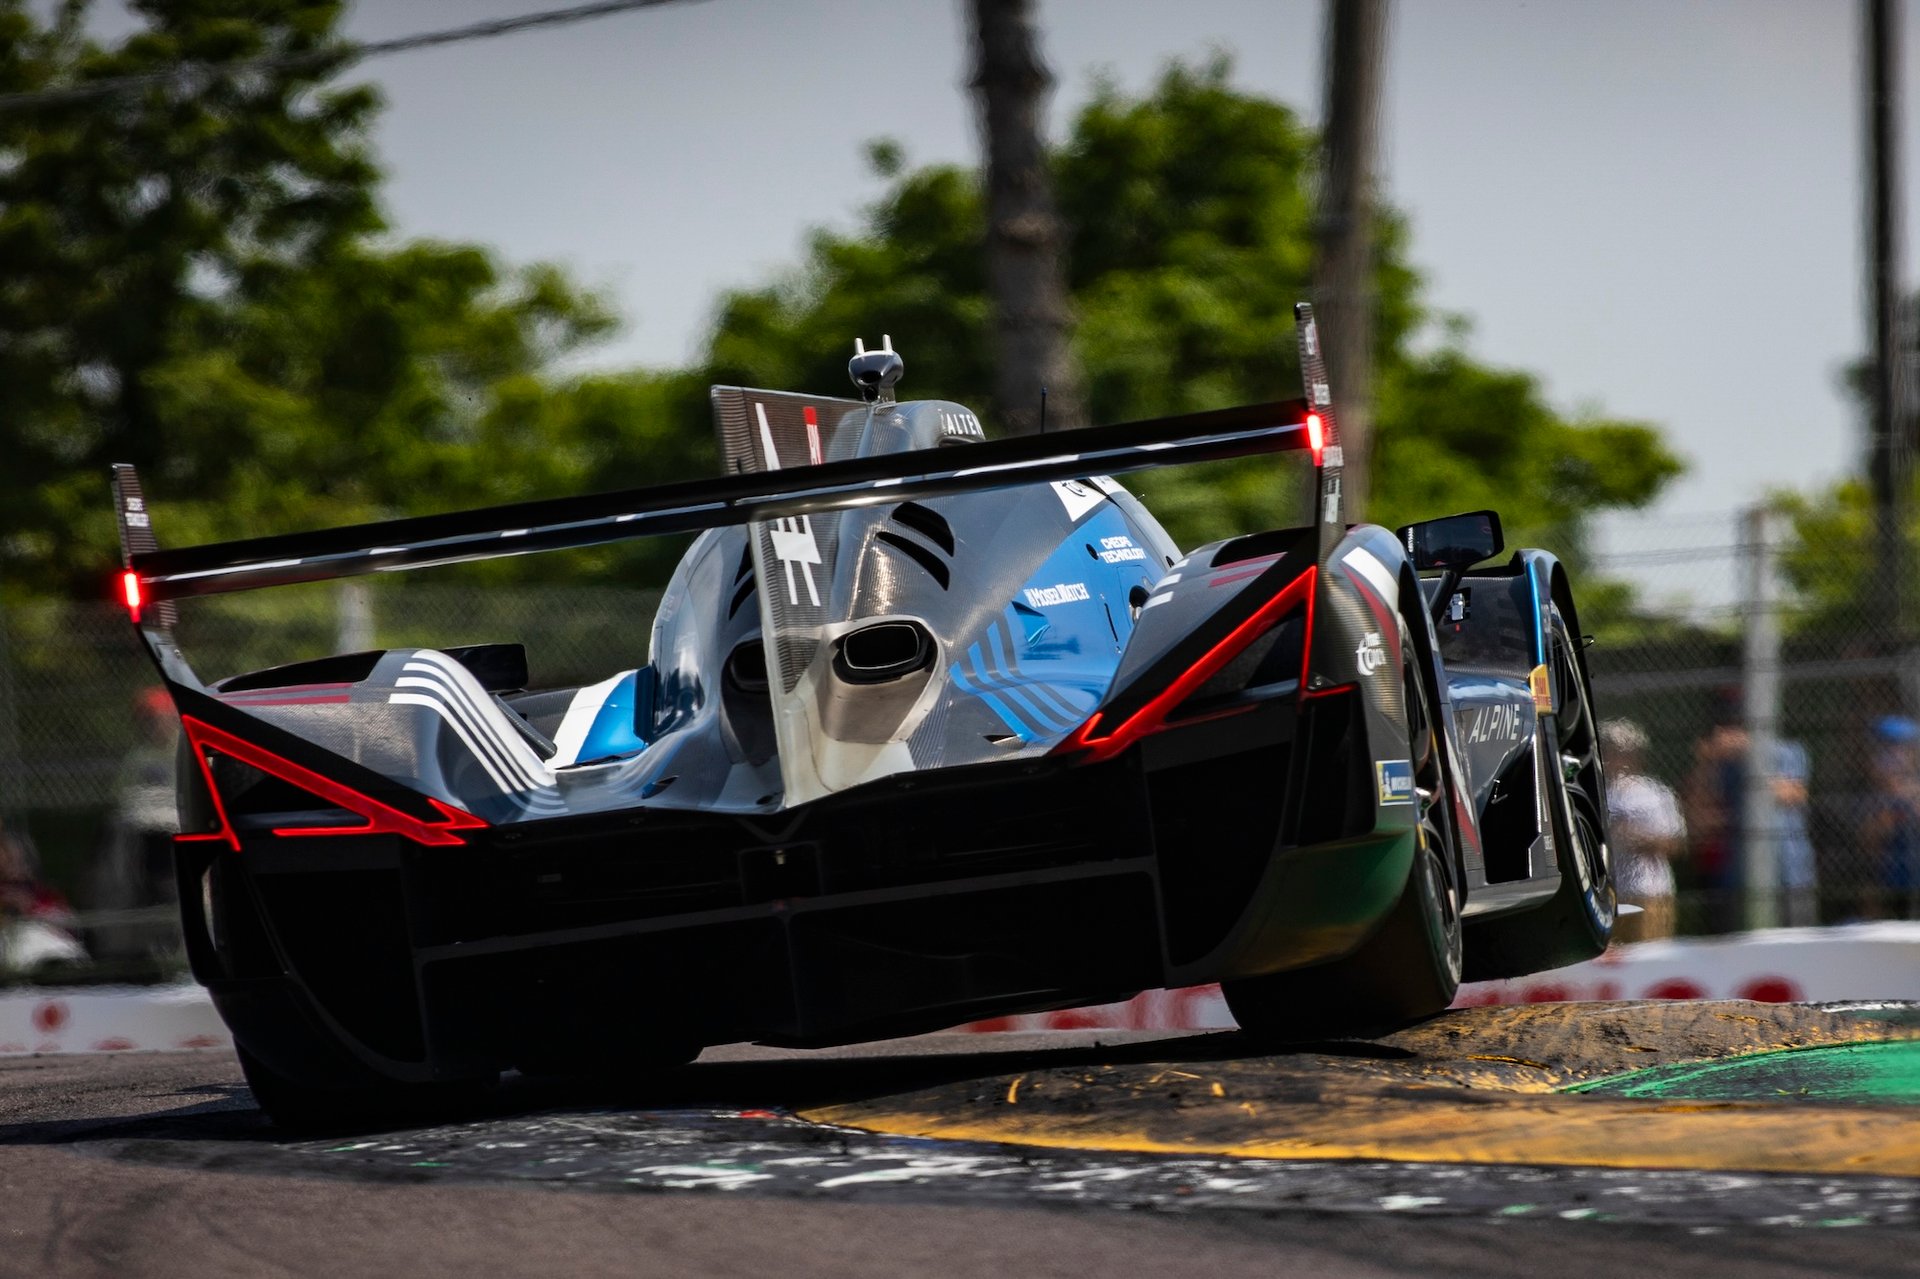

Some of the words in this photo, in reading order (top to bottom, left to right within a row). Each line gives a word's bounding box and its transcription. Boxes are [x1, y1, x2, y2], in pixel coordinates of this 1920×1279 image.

[947, 413, 984, 436] ALTEN
[1100, 548, 1146, 563] TECHNOLOGY
[1468, 703, 1520, 744] ALPINE
